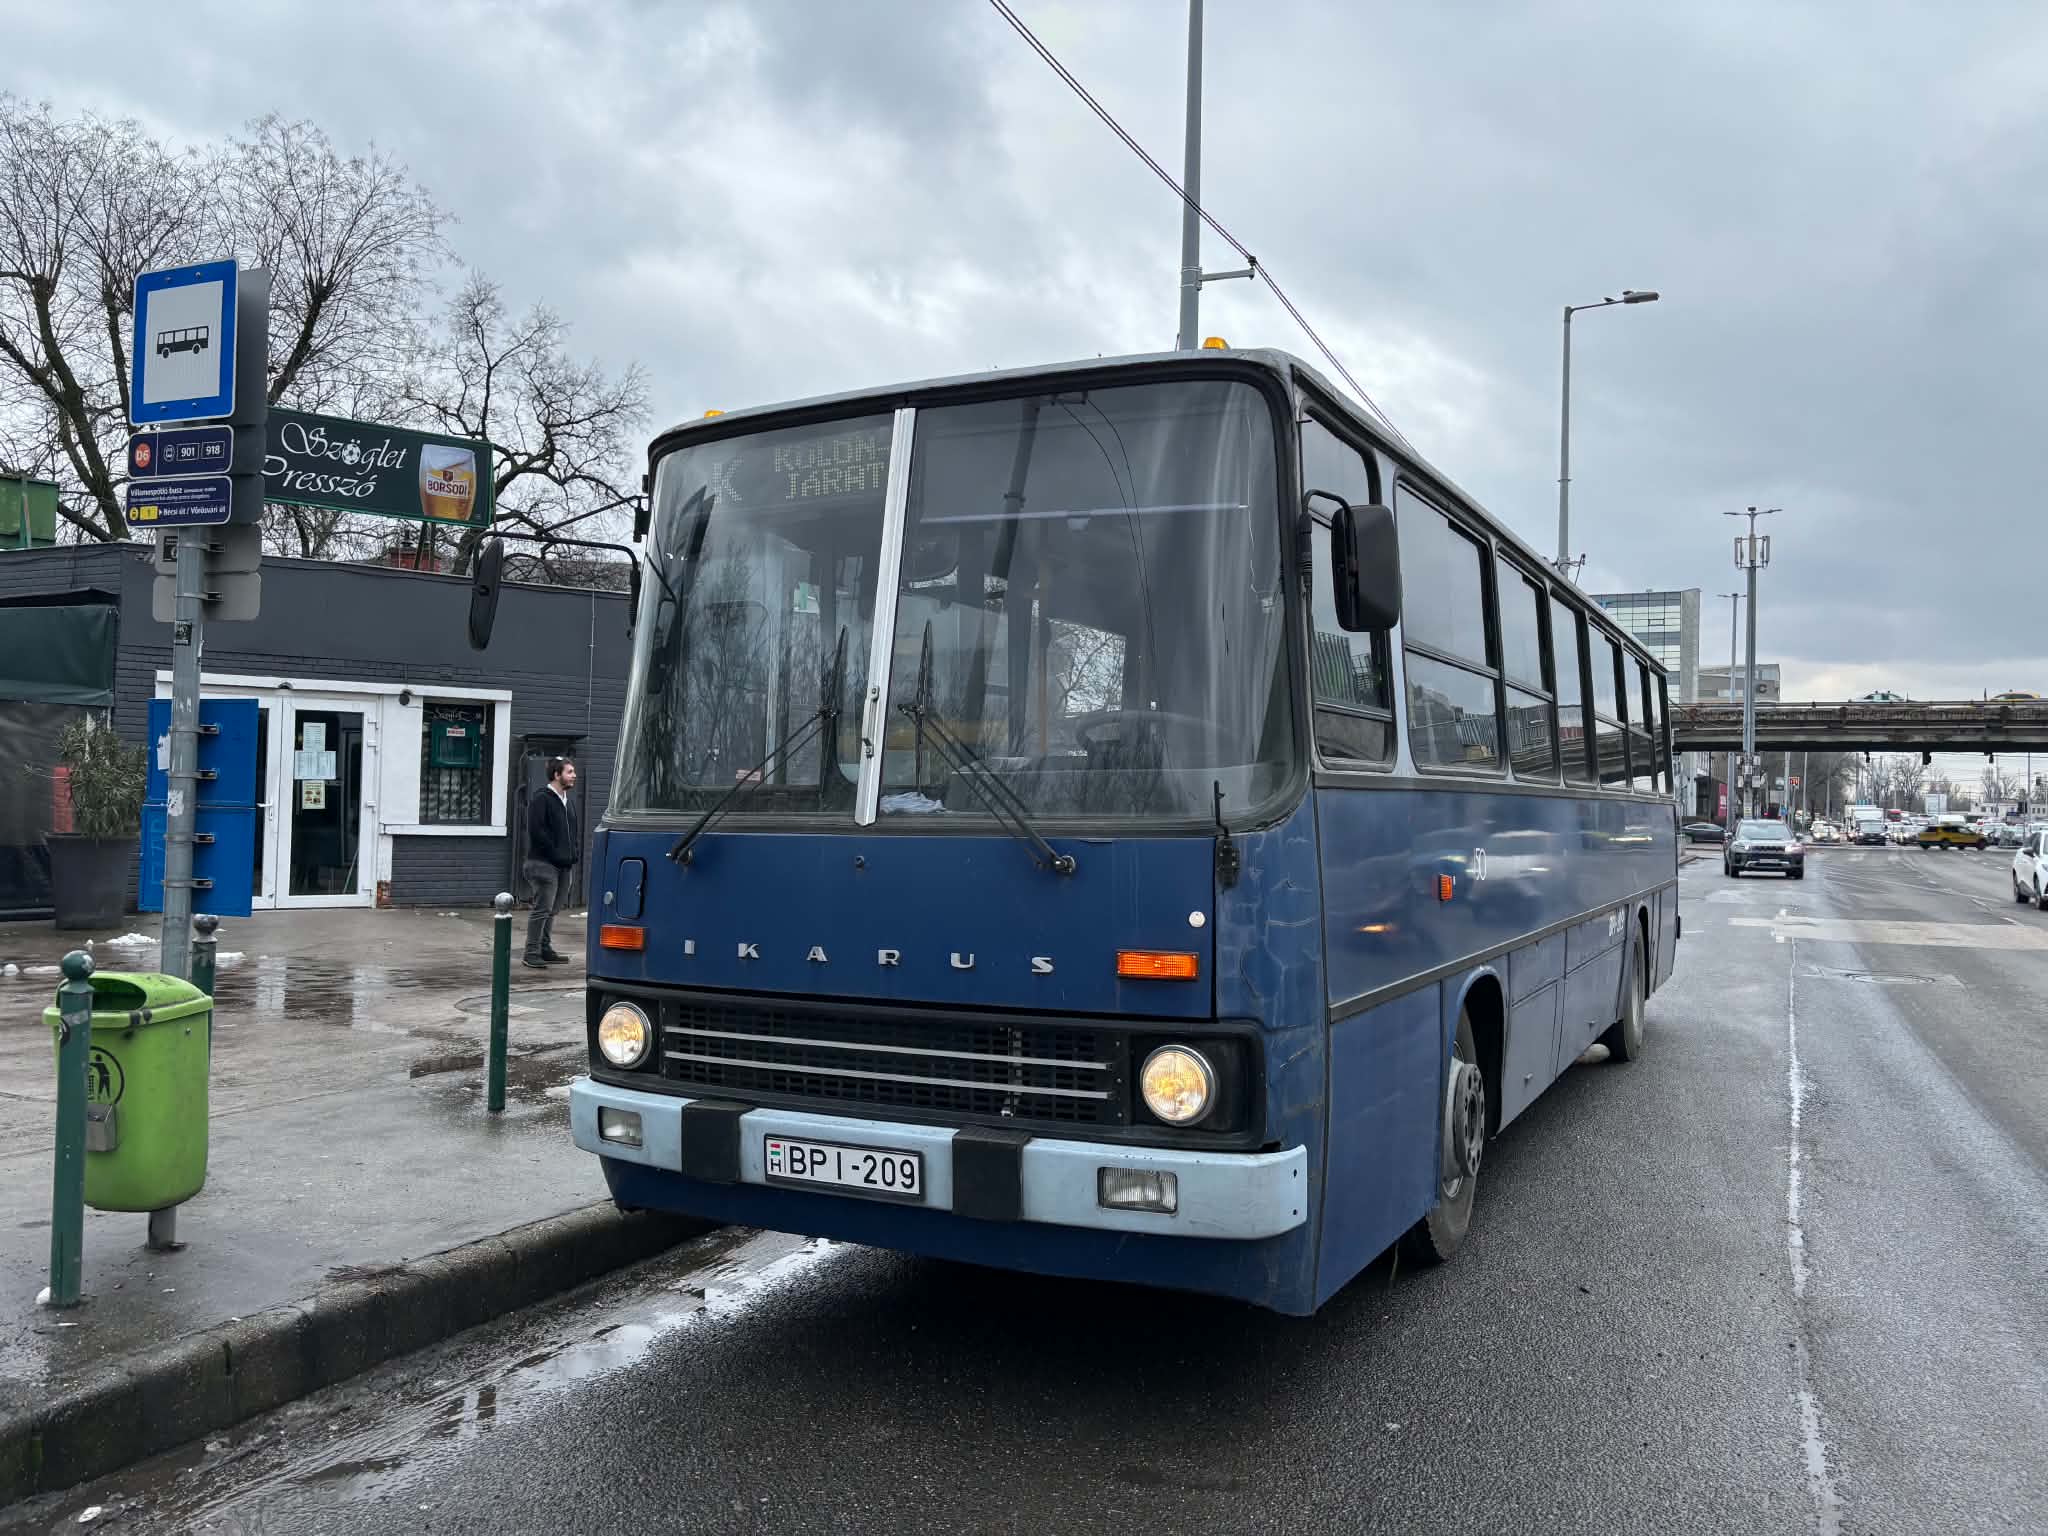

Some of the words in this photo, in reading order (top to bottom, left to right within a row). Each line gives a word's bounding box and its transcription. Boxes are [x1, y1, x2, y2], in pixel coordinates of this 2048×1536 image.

[181, 447, 195, 457] 901
[206, 444, 221, 456] 918
[427, 479, 468, 496] BORSODI
[712, 456, 744, 504] K
[684, 939, 1055, 974] IKARUS
[770, 1158, 782, 1173] H
[789, 1145, 916, 1190] BPI-209
